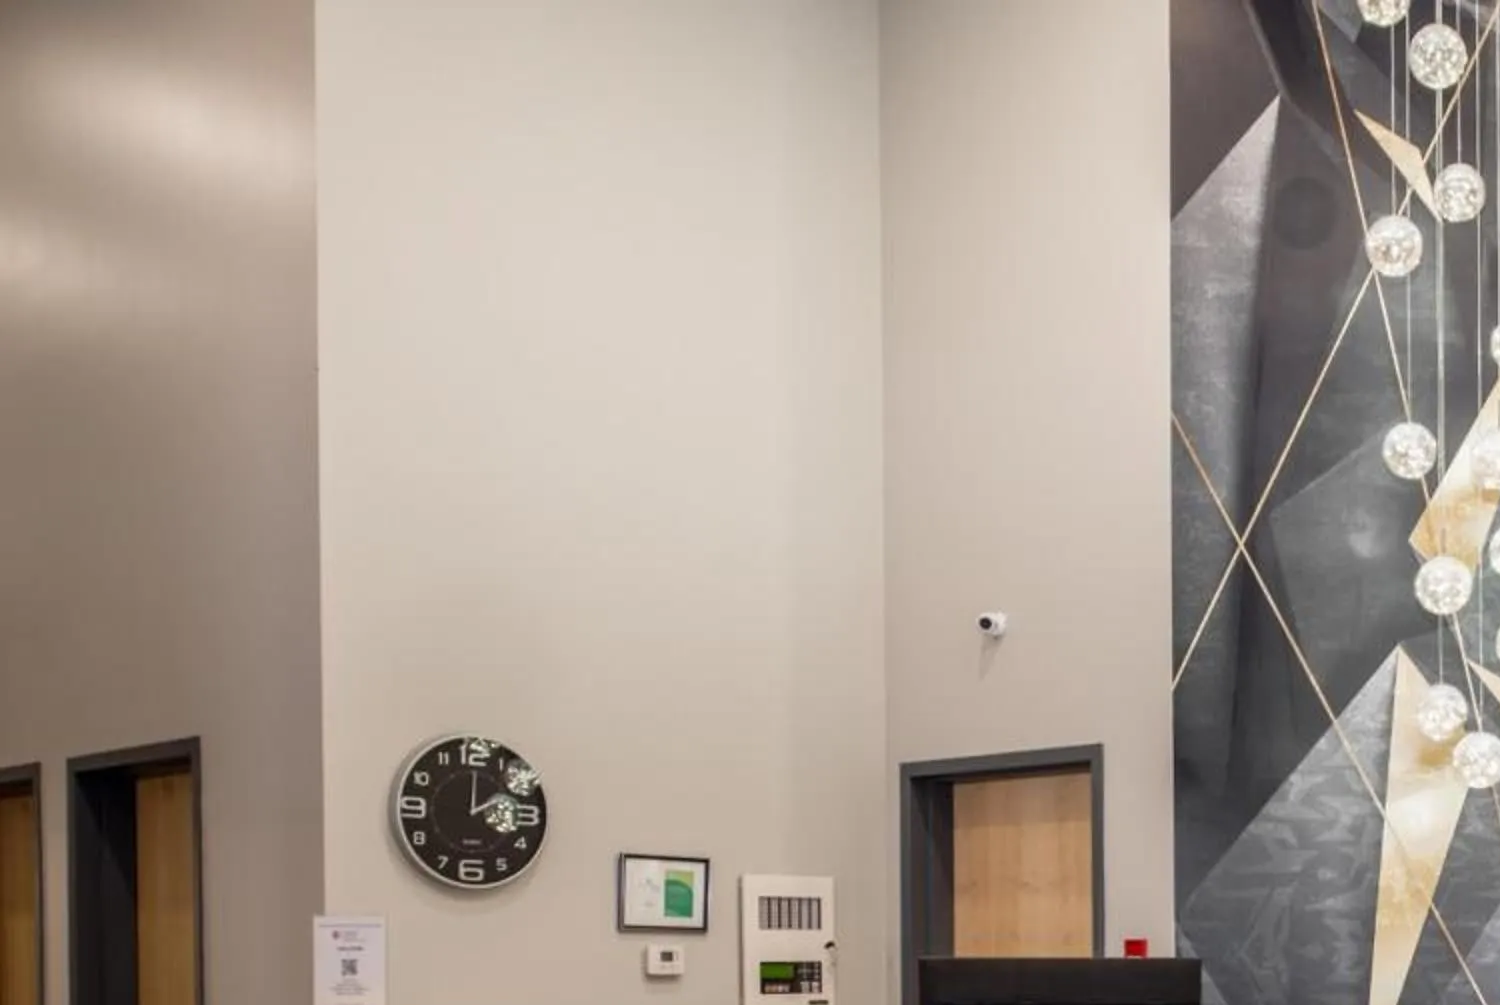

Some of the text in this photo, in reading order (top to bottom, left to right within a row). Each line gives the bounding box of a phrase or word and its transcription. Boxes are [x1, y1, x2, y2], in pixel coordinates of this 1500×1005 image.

[438, 752, 449, 765] 11
[499, 758, 504, 772] 1
[413, 771, 430, 786] 10
[401, 796, 427, 819] 9
[516, 804, 540, 826] 3
[413, 831, 426, 846] 8
[513, 836, 528, 850] 4
[437, 855, 449, 869] 7
[496, 857, 508, 871] 5
[458, 859, 485, 881] 6
